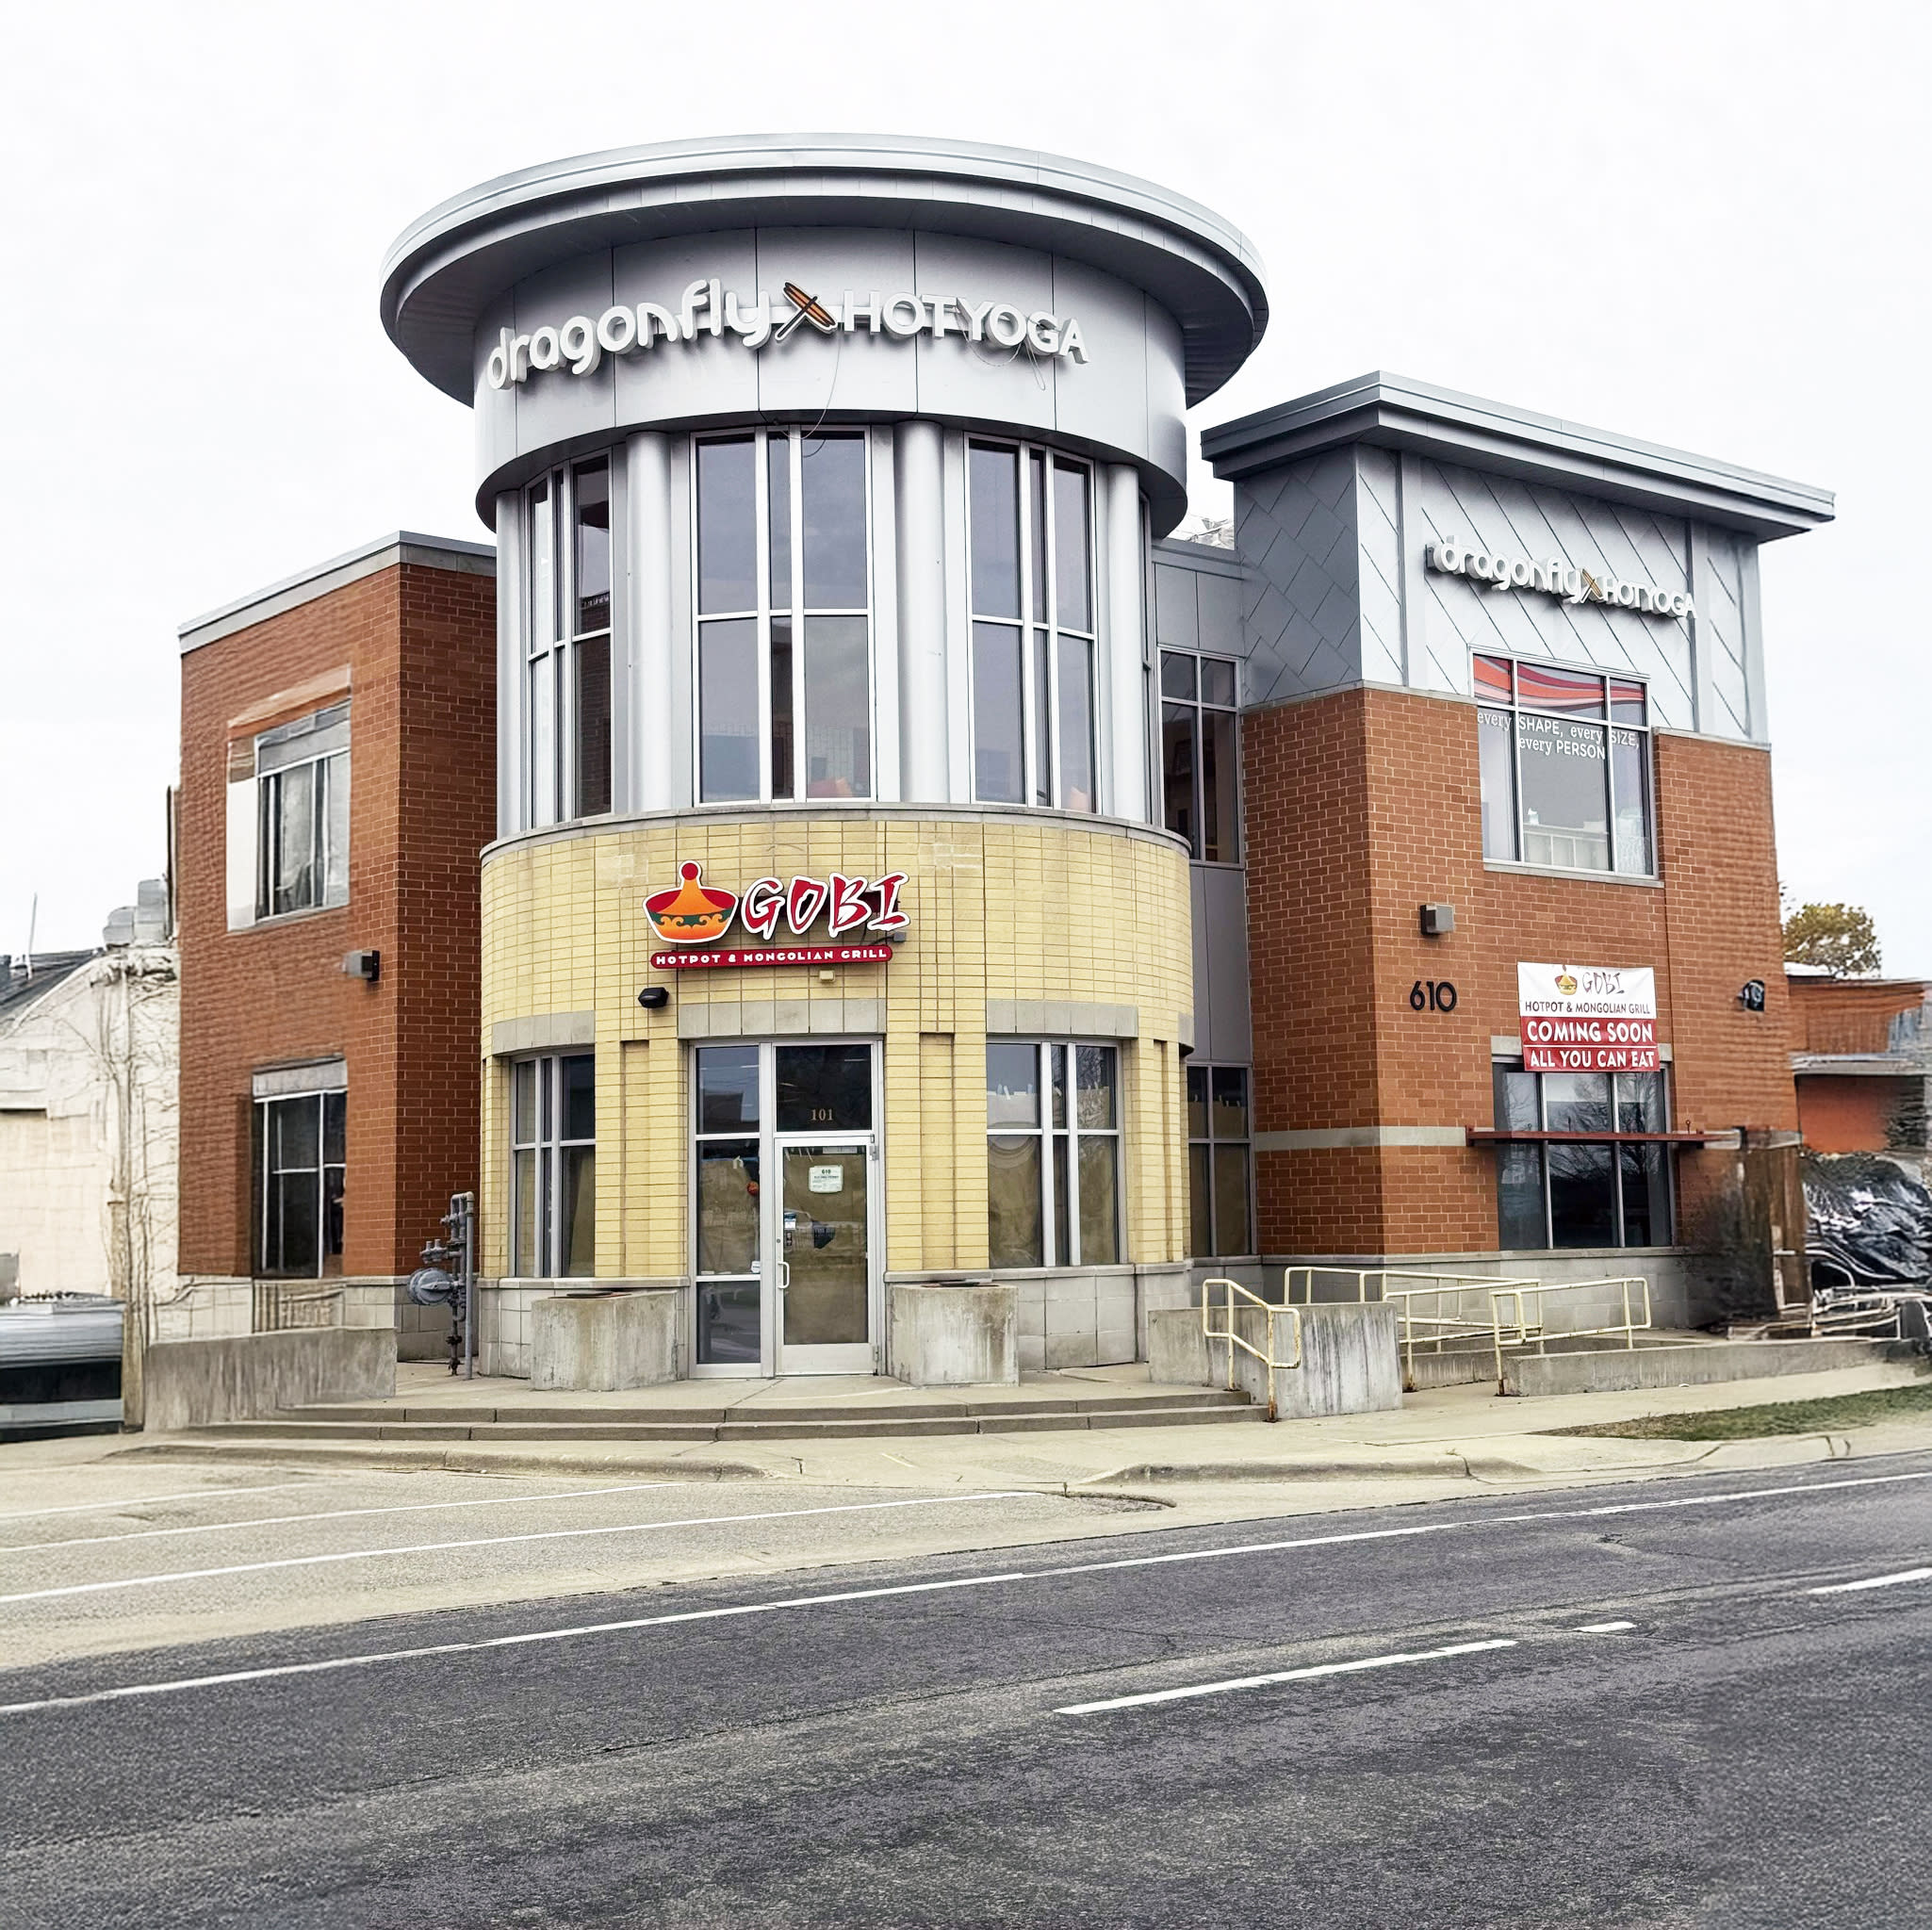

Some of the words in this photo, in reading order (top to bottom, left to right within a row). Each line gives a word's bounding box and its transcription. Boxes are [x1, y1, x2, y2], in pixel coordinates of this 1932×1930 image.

[487, 279, 773, 389] dragonfly
[1432, 535, 1584, 604] dragonfly
[1477, 711, 1512, 731] every
[1518, 715, 1564, 738] SHAPE,
[1570, 725, 1603, 744] every
[1610, 730, 1640, 750] SIZE,
[1518, 736, 1552, 756] every
[1555, 741, 1606, 761] PERSON
[742, 872, 910, 940] GOBI
[655, 954, 721, 965] HOTPOT
[728, 954, 736, 963] &
[743, 951, 834, 962] MONGOLIAN
[840, 949, 887, 959] GRILL
[1581, 971, 1626, 995] GOBI
[1410, 981, 1457, 1011] 610
[1525, 1001, 1564, 1013] HOTPOT
[1565, 1002, 1573, 1013] &
[1575, 1003, 1628, 1014] MONGOLIAN
[1628, 1004, 1651, 1015] GRILL
[1526, 1021, 1601, 1042] COMING
[1606, 1022, 1654, 1042] SOON
[1530, 1050, 1556, 1068] ALL
[1560, 1050, 1593, 1068] YOU
[1596, 1051, 1628, 1068] CAN
[1631, 1051, 1655, 1068] EAT
[810, 1108, 833, 1121] 101
